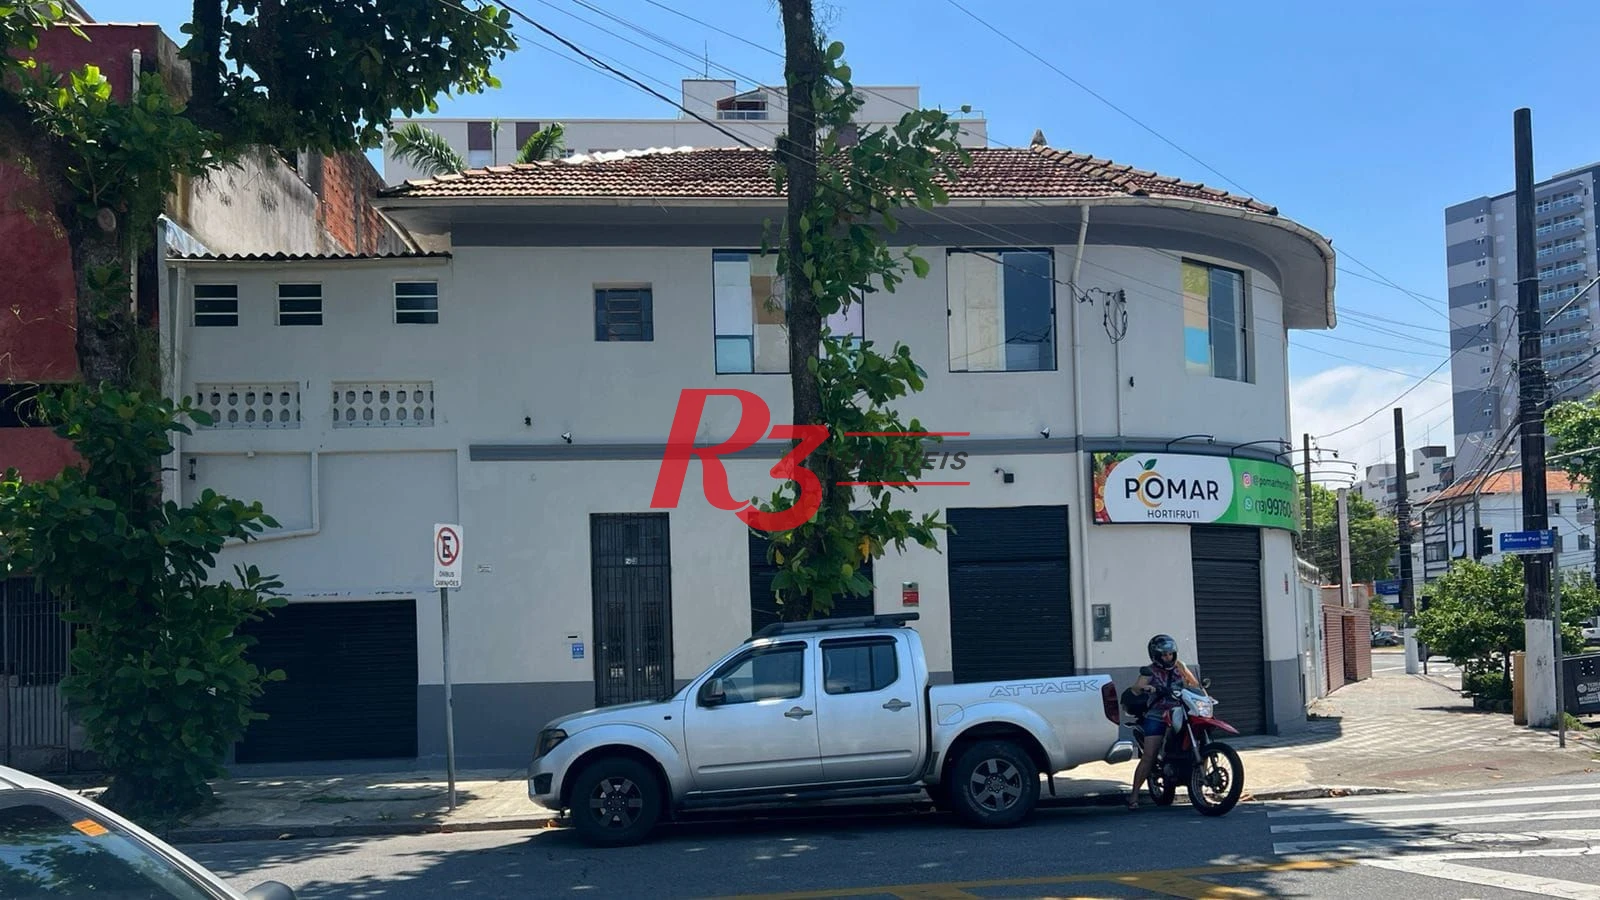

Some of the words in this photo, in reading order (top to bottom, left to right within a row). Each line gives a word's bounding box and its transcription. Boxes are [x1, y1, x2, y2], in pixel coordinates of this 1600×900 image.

[1125, 478, 1219, 501] POMAR
[1147, 509, 1200, 519] HORTIFRUTI
[989, 679, 1099, 698] ATTACK
